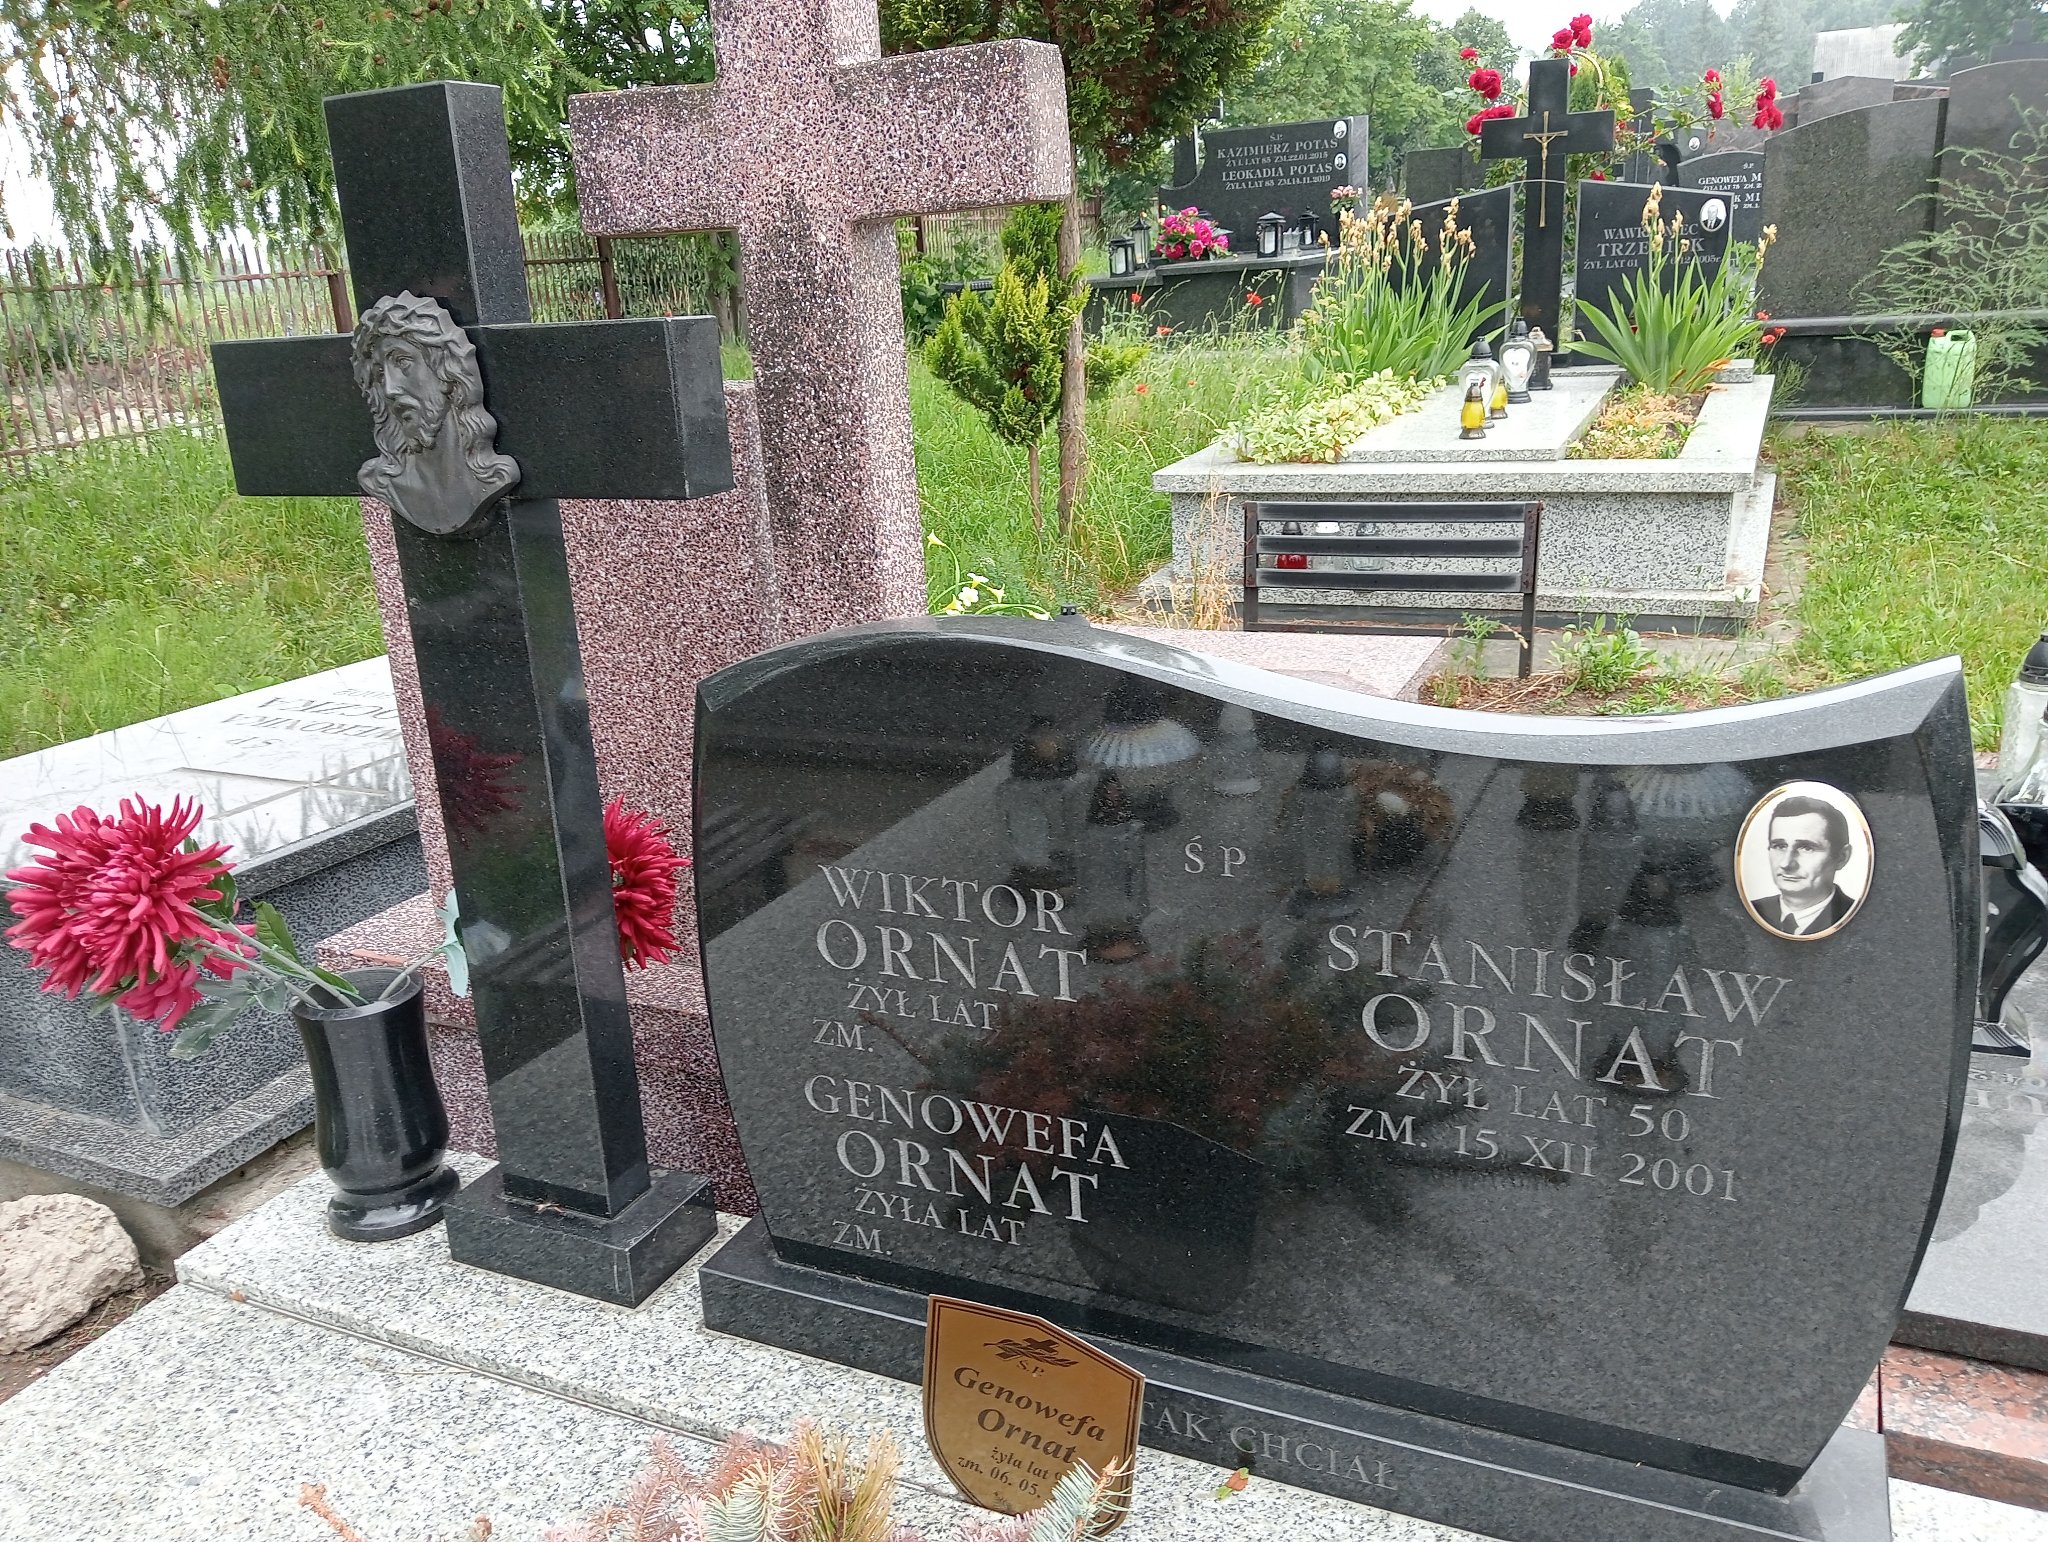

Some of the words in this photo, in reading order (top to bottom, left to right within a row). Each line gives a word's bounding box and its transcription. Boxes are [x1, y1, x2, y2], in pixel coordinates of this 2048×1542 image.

[1217, 142, 1290, 159] KAZIMIERZ
[1295, 138, 1338, 152] POTAS
[1222, 166, 1284, 181] LEOKADIA
[1290, 162, 1333, 176] POTAS
[1245, 157, 1260, 167] LAT
[1248, 180, 1264, 188] LAT
[1698, 174, 1748, 185] GENOWEFA
[1583, 259, 1602, 270] ŻYŁ
[1606, 259, 1625, 269] LAT
[1596, 237, 1705, 257] TRZEIK
[818, 864, 1072, 936] WIKTOR
[816, 919, 1087, 1003] ORNAT
[1327, 925, 1793, 1027] STANISŁAW
[847, 977, 916, 1018] ŻYŁ
[930, 994, 998, 1030] LAT
[812, 1017, 874, 1053] ZM.
[1362, 993, 1744, 1100] ORNAT
[804, 1074, 1130, 1170] GENOWEFA
[1395, 1061, 1490, 1110] ŻYŁ
[1510, 1084, 1607, 1128] LAT
[1628, 1104, 1690, 1142] 50
[836, 1130, 1098, 1224] ORNAT
[1345, 1104, 1428, 1148] ZM.
[1454, 1124, 1499, 1160] 15
[1520, 1134, 1598, 1178] XII
[1619, 1153, 1738, 1202] 2001
[832, 1220, 893, 1256] ZM.
[854, 1182, 943, 1230] ŻYŁA
[958, 1207, 1025, 1246] LAT
[953, 1366, 1105, 1443] Genowefa
[977, 1407, 1080, 1464] Ornat
[990, 1446, 1022, 1470] żyła
[1027, 1461, 1049, 1480] lat
[1229, 1425, 1397, 1491] CHCIAŁ
[957, 1456, 983, 1474] zm.
